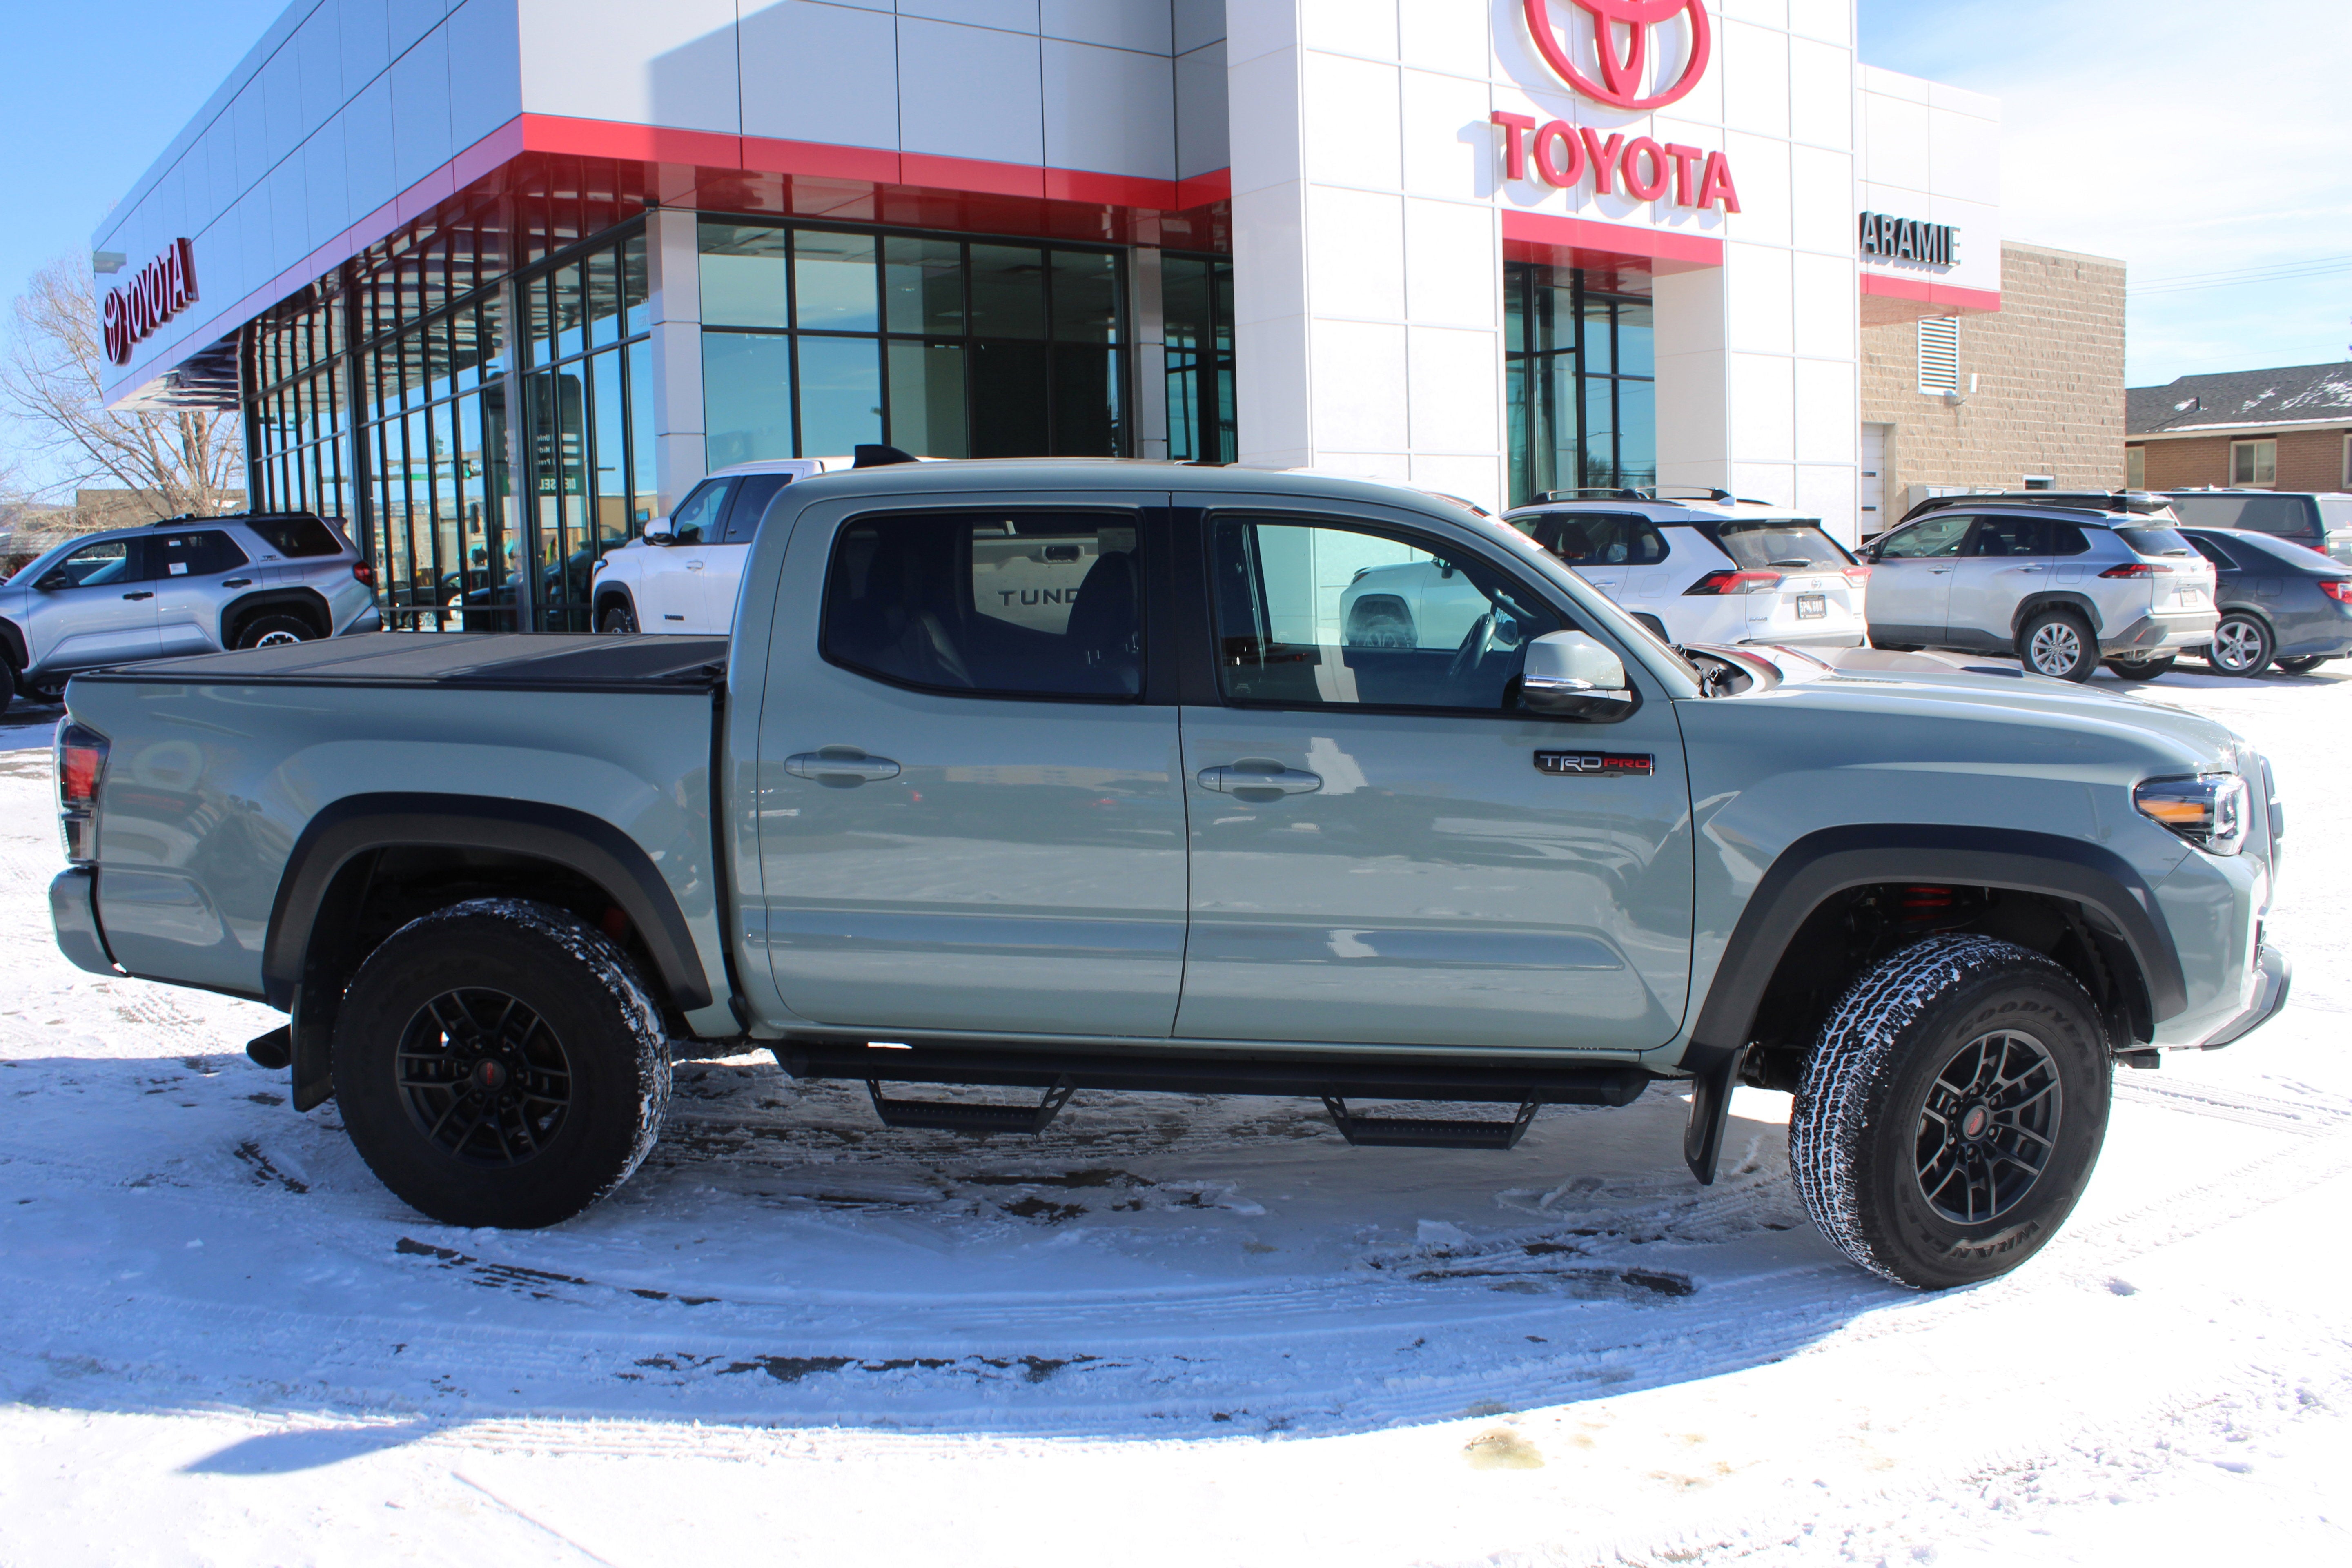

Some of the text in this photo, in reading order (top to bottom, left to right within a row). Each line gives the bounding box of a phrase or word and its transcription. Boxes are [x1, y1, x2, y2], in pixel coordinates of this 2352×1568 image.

[1491, 111, 1740, 213] TOYOTA
[1859, 211, 1961, 265] ARAMIE
[121, 237, 194, 344] TOYOTA
[997, 588, 1079, 606] TUND
[1539, 755, 1650, 771] TRD PRO
[1956, 1001, 2096, 1087] GOODYEAR
[1899, 1184, 2040, 1261] WRANGLER
